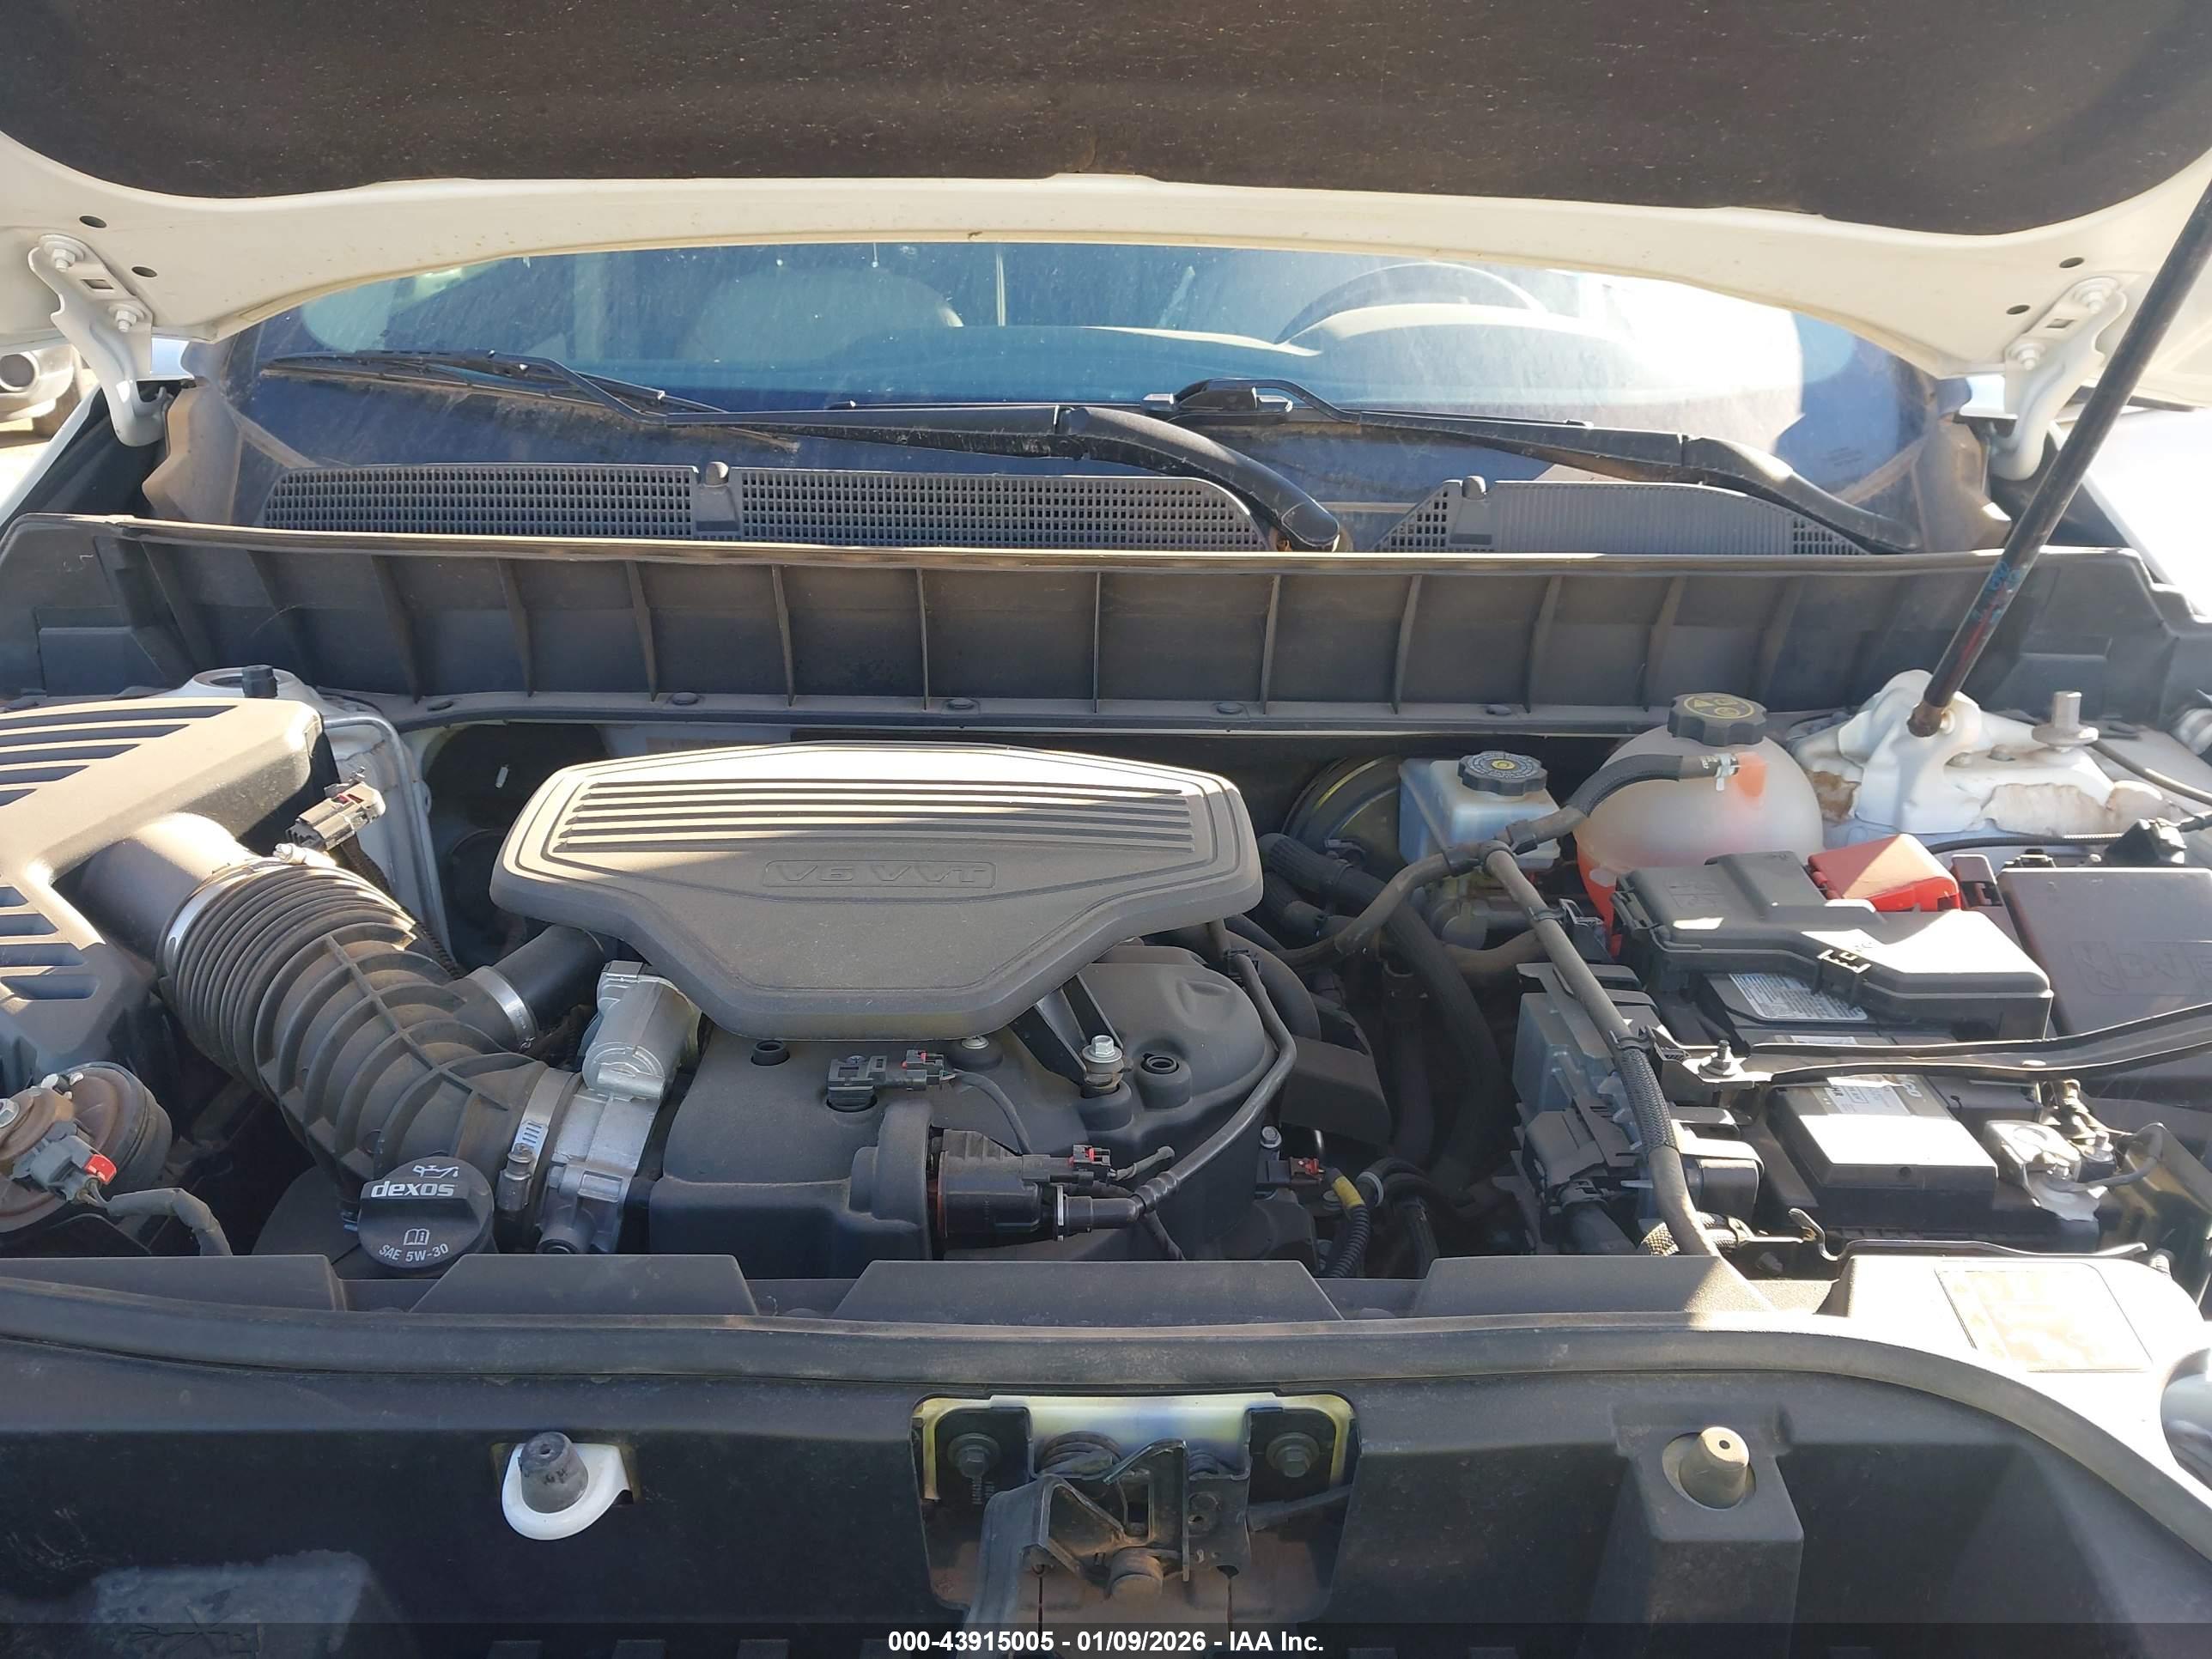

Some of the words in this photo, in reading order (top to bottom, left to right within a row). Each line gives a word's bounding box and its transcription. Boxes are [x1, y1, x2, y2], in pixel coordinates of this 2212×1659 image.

[777, 864, 854, 882] V6
[870, 864, 988, 883] VVT
[370, 1180, 456, 1198] dexos
[378, 1244, 403, 1261] SAE
[405, 1243, 449, 1262] 5W-30
